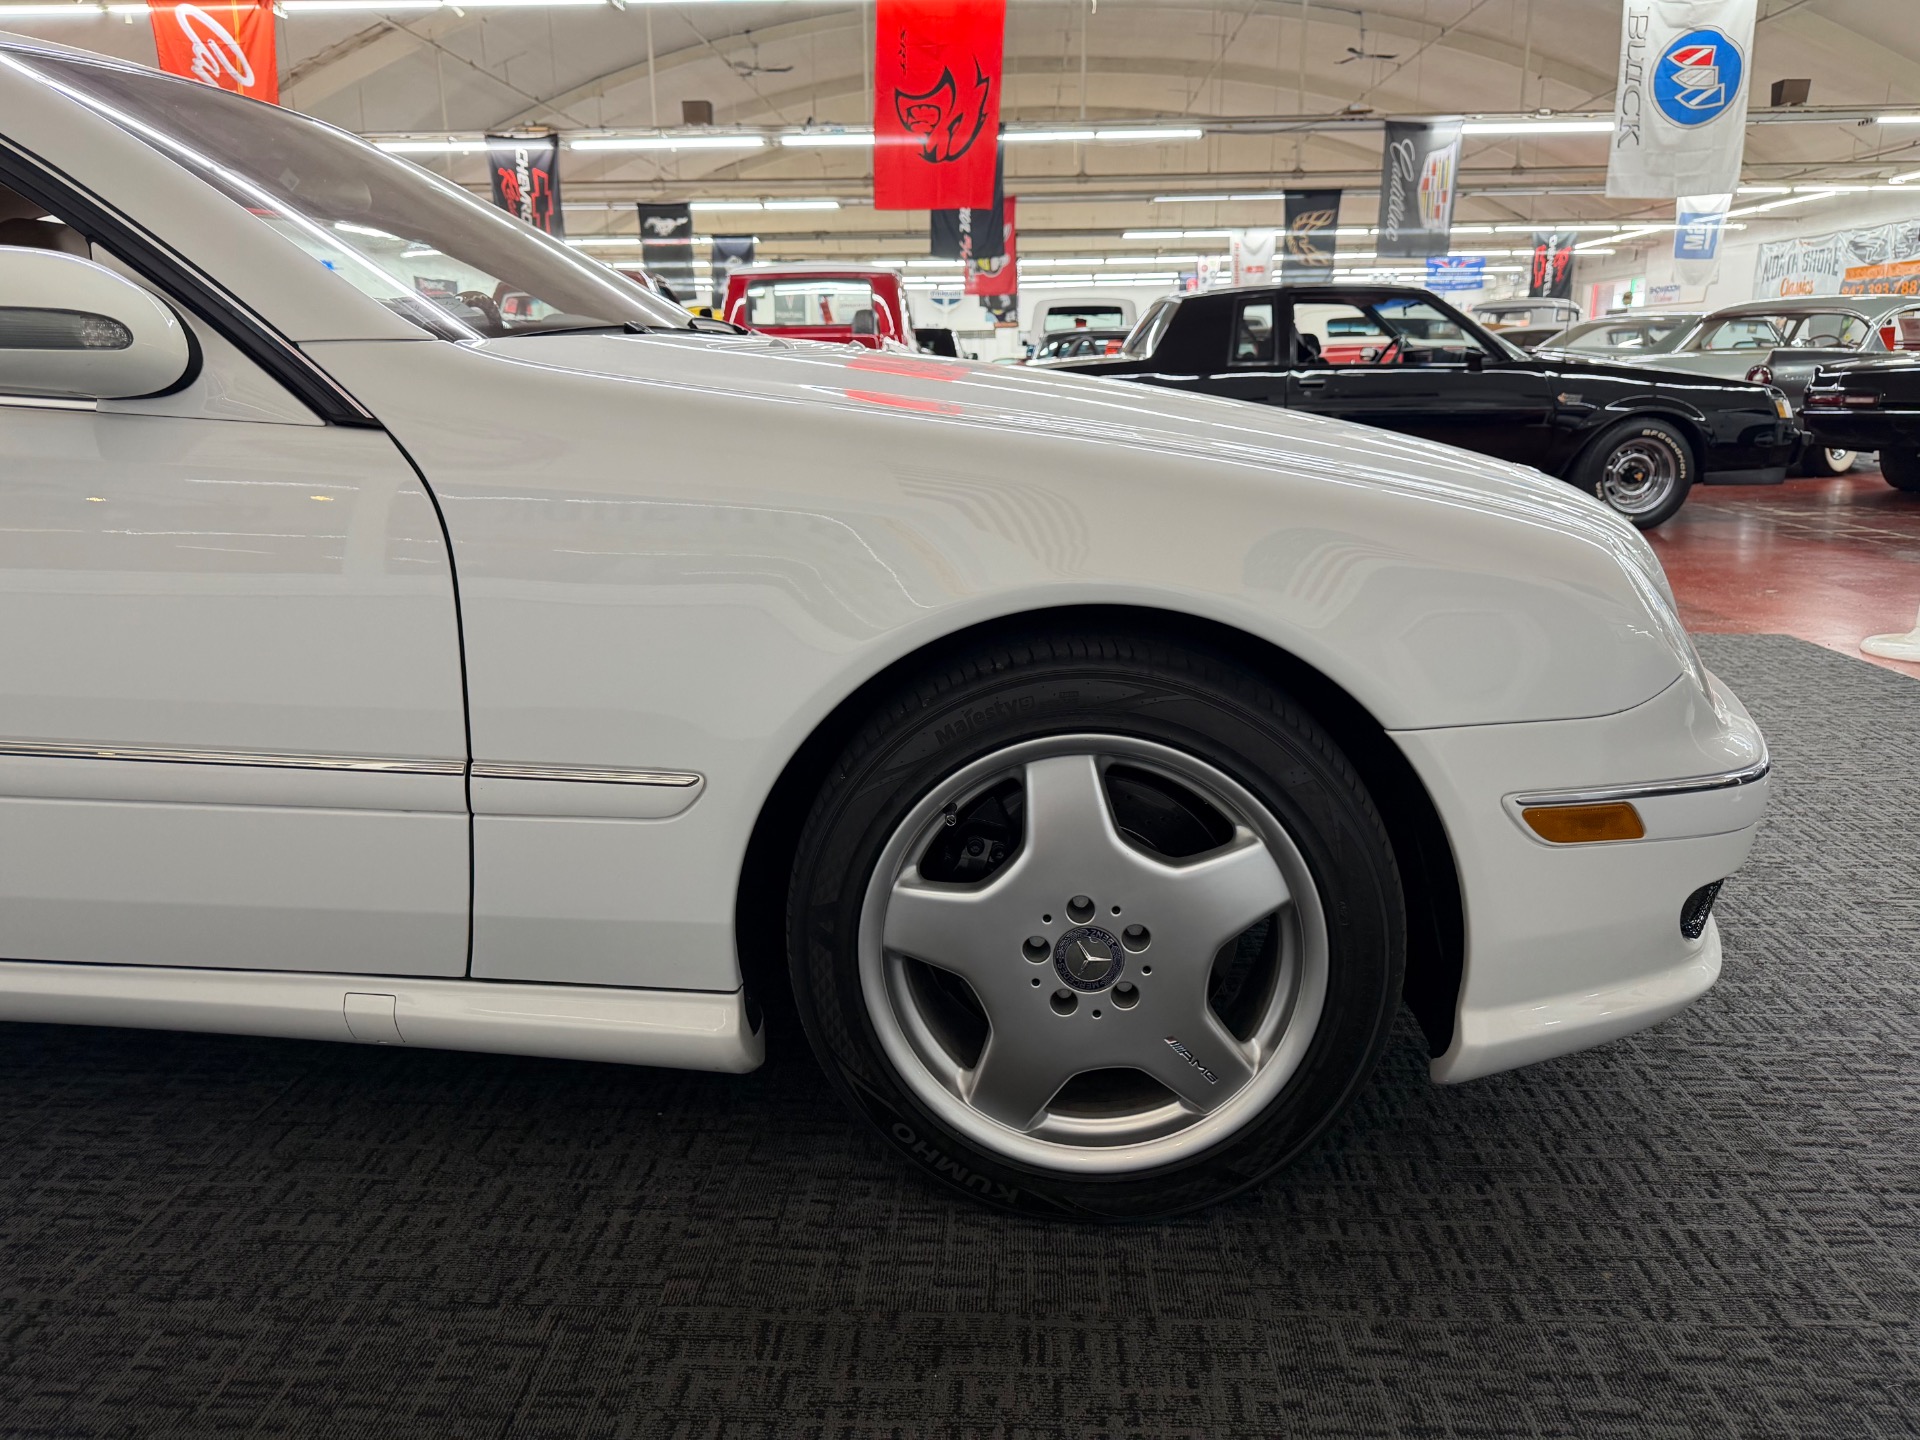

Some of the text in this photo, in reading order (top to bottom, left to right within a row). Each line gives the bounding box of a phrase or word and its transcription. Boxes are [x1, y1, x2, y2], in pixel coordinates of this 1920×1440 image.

[1617, 6, 1650, 149] BUICK
[1386, 139, 1415, 241] Cadillac
[1762, 250, 1799, 284] NORTH
[1801, 246, 1841, 277] SHORE
[1780, 275, 1814, 297] Classics
[1090, 929, 1115, 946] BENZ
[1057, 961, 1100, 990] MERCEDES
[891, 1122, 1019, 1204] KUMHO
